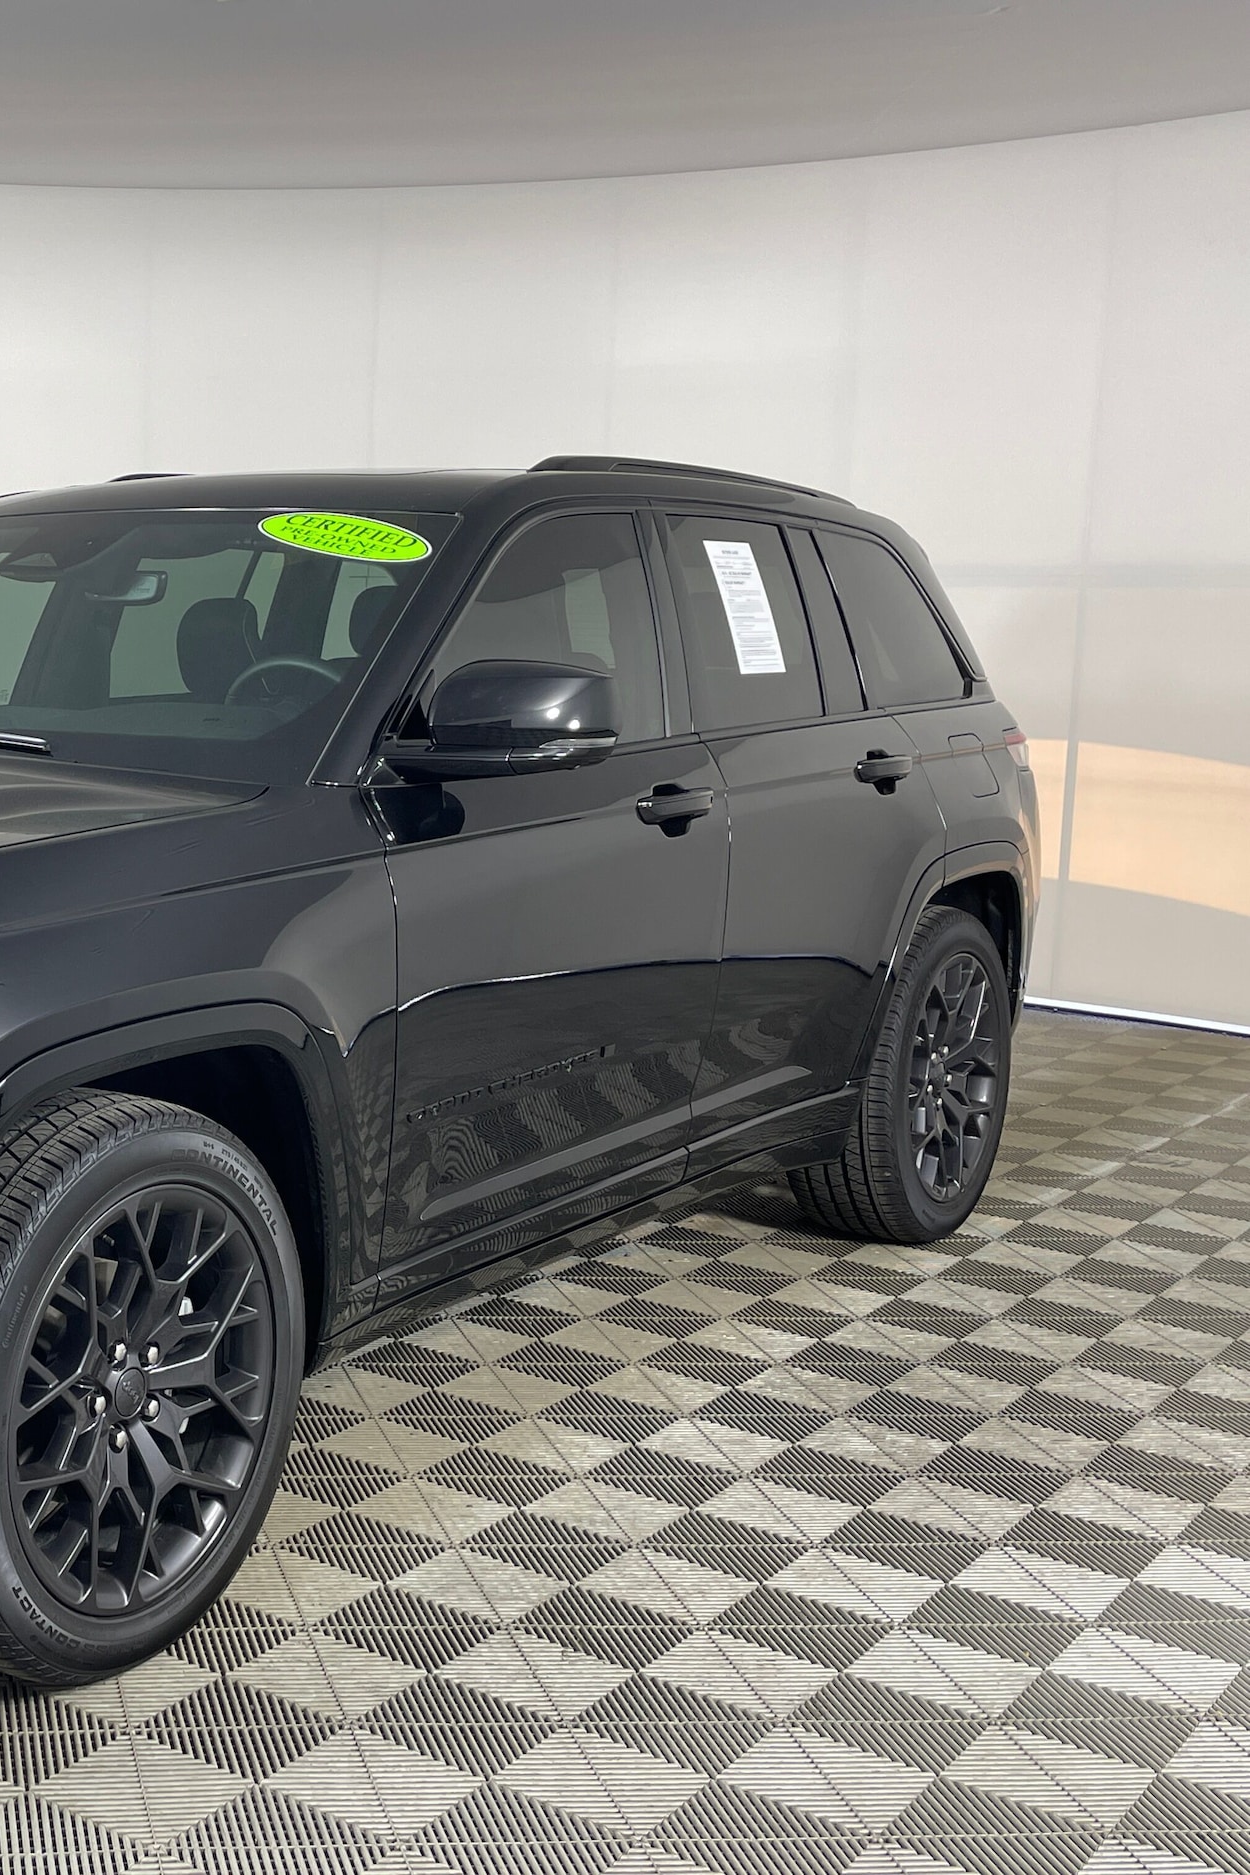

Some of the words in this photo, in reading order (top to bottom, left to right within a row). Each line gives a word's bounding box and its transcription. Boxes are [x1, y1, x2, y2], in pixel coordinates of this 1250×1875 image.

[280, 525, 397, 554] PRE-OWNED
[285, 513, 418, 548] CERTIFIED
[291, 533, 372, 556] VEHICLE
[171, 1148, 277, 1236] CONTINENTAL
